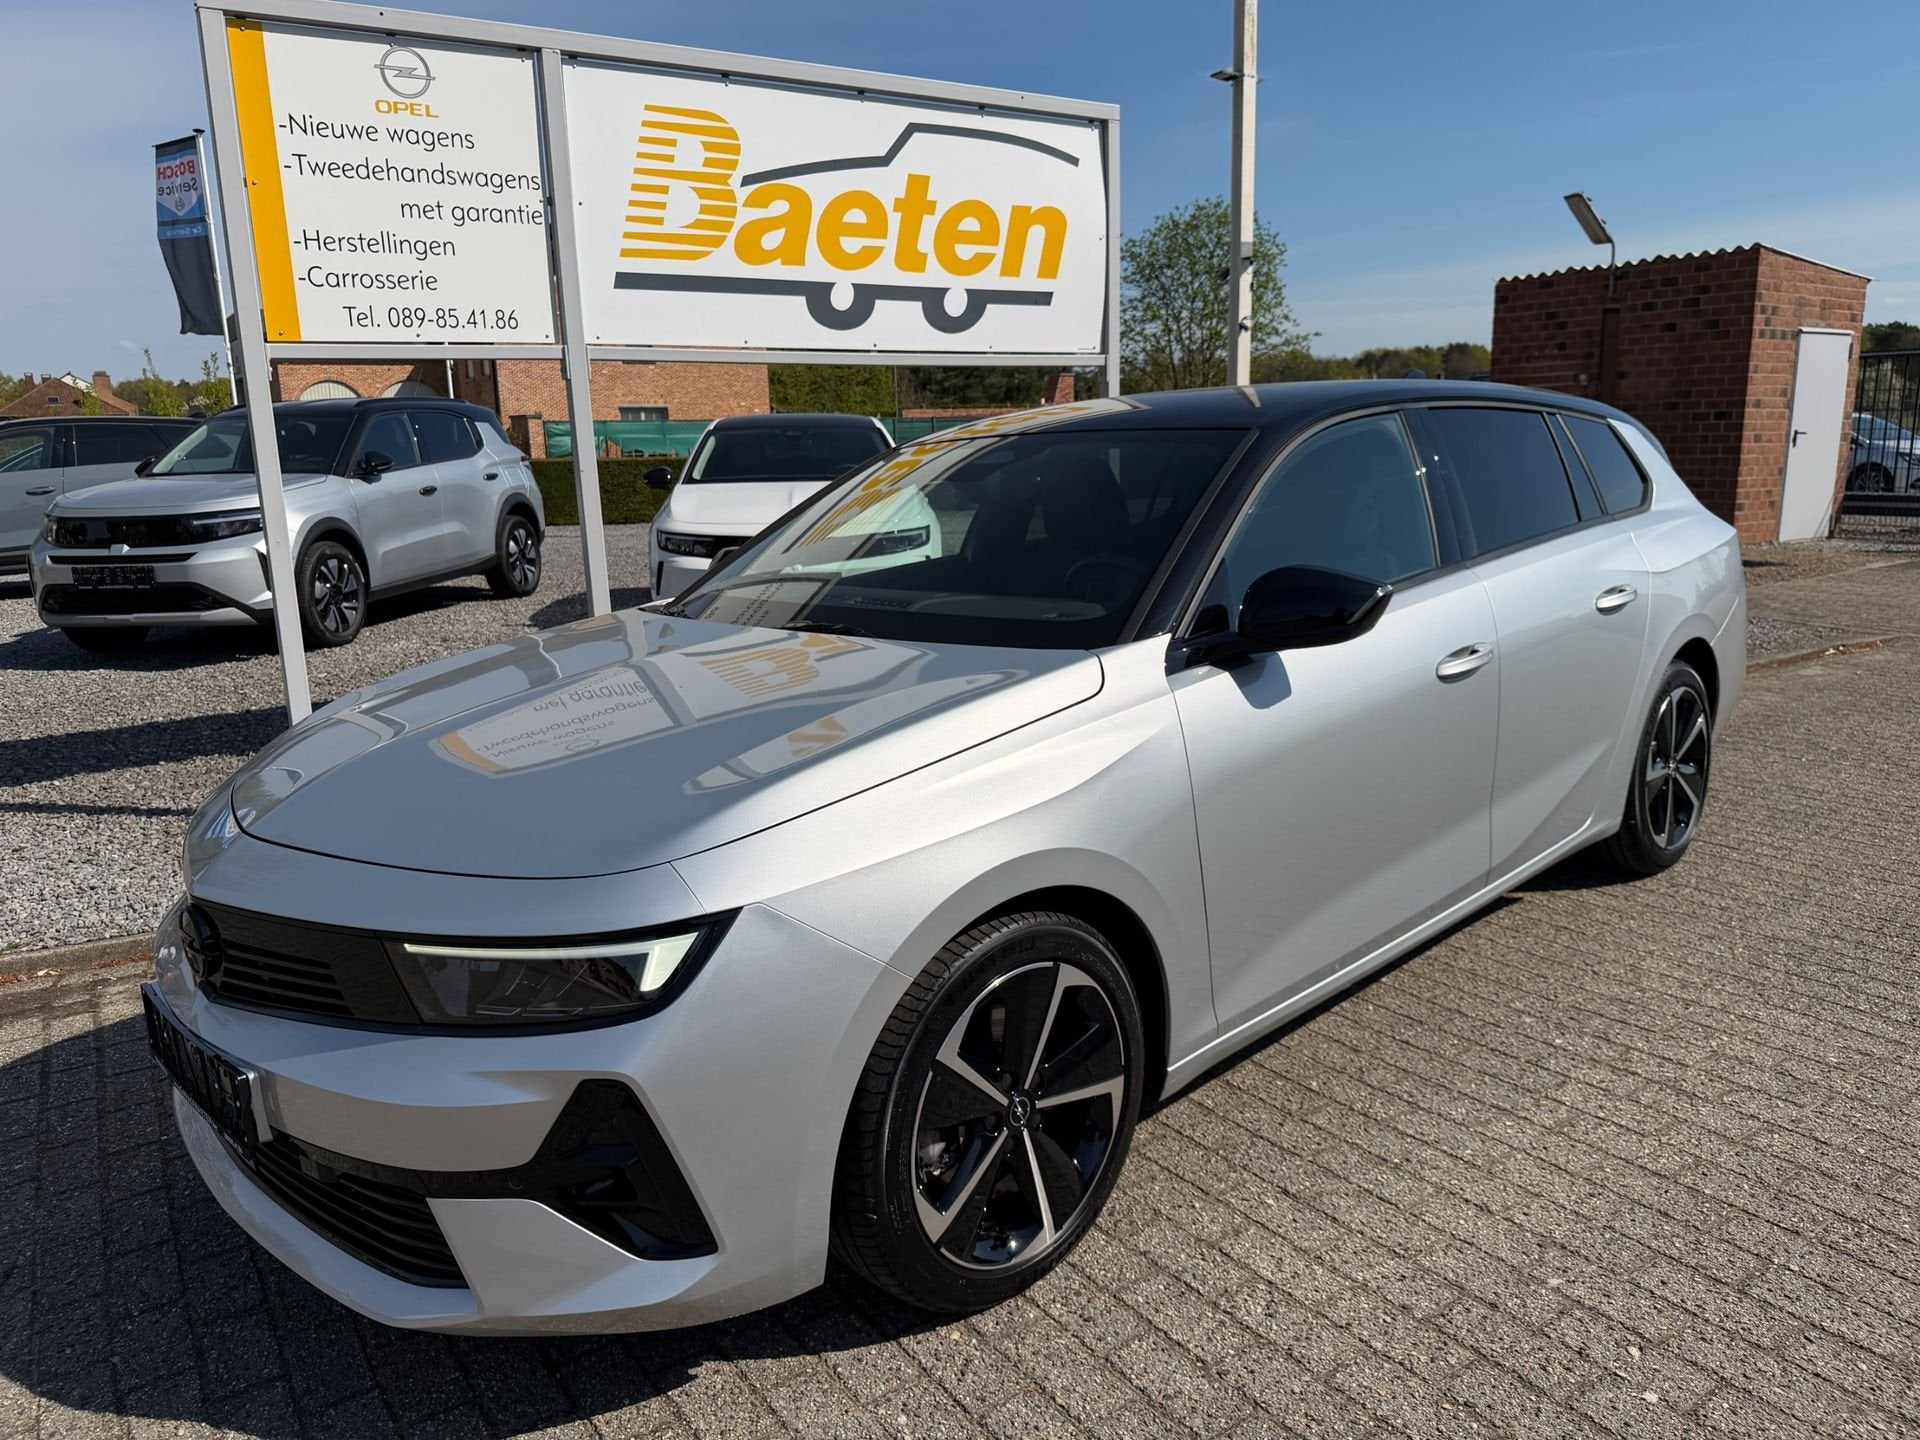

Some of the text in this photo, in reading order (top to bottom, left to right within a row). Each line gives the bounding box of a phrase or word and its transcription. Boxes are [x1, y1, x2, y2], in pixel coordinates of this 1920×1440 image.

[374, 99, 439, 118] OPEL
[386, 128, 475, 152] wagens
[619, 103, 1068, 281] Baeten
[401, 201, 543, 227] met garantie
[342, 305, 519, 330] Tel. 089-85.41.86
